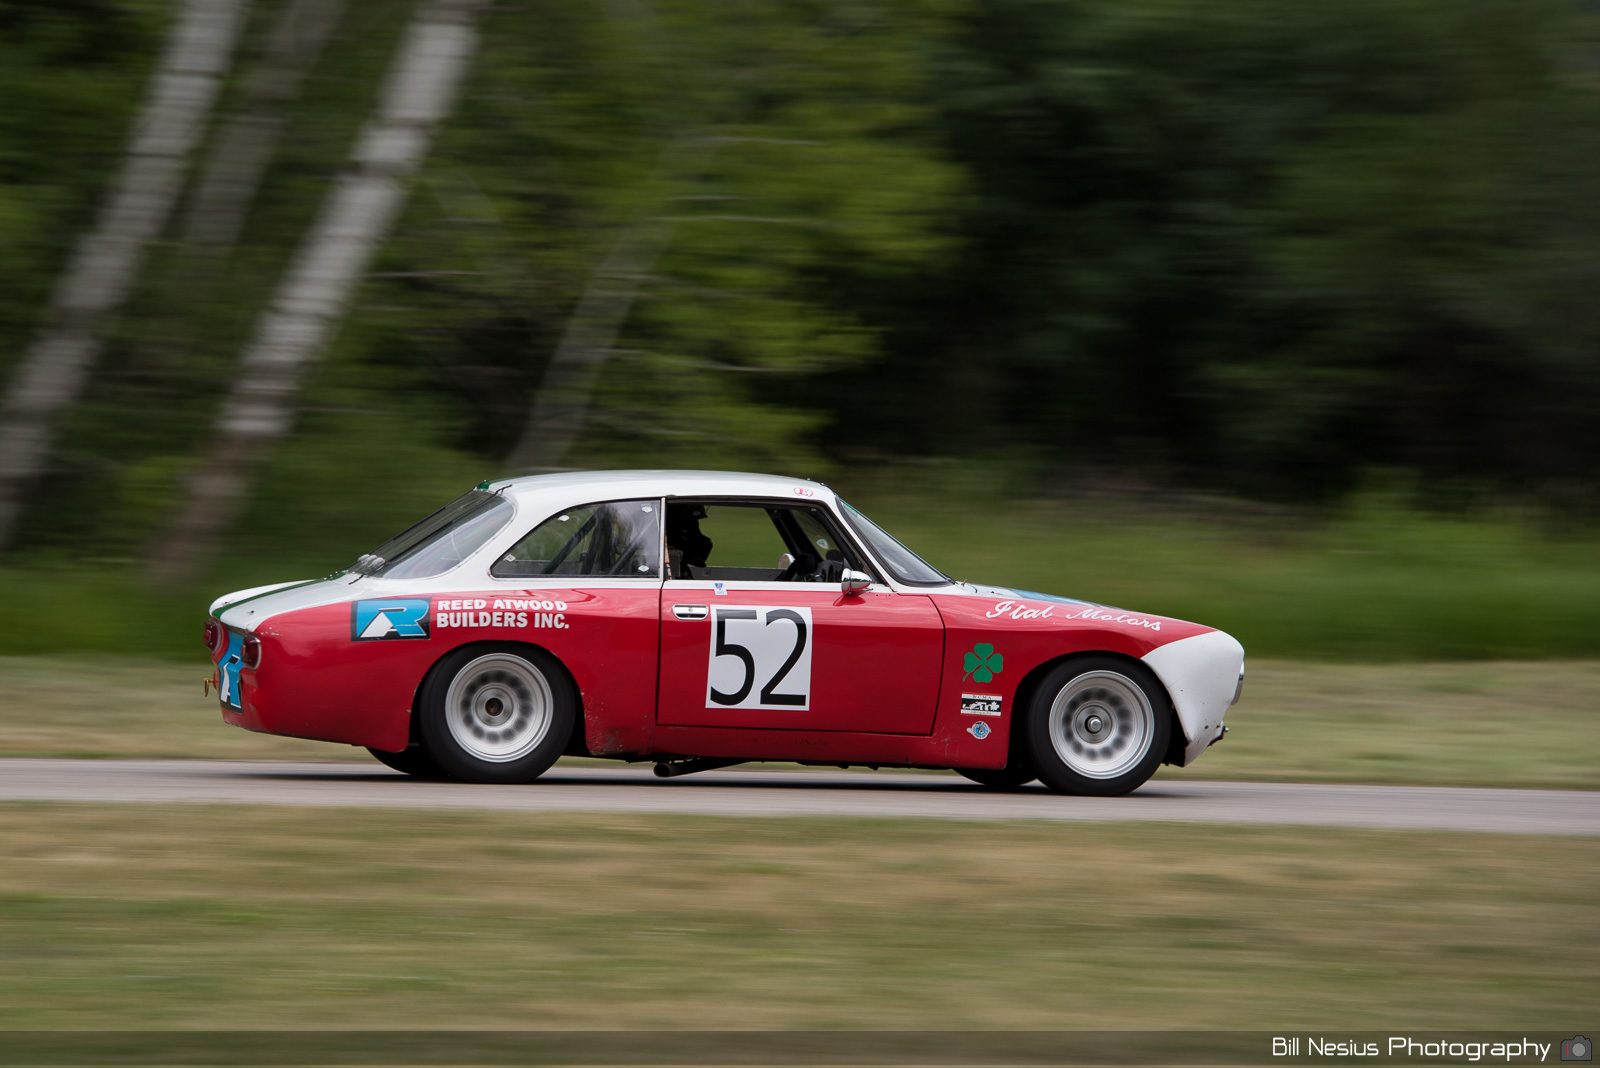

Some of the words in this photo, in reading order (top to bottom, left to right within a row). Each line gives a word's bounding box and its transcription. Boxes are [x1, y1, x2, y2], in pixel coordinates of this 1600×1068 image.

[437, 600, 487, 611] REED
[493, 600, 568, 611] ATWOOD
[986, 601, 1054, 620] Ital
[1066, 608, 1161, 631] Motors
[436, 612, 528, 628] BUILDERS
[534, 613, 570, 629] INC.
[710, 608, 807, 706] 52
